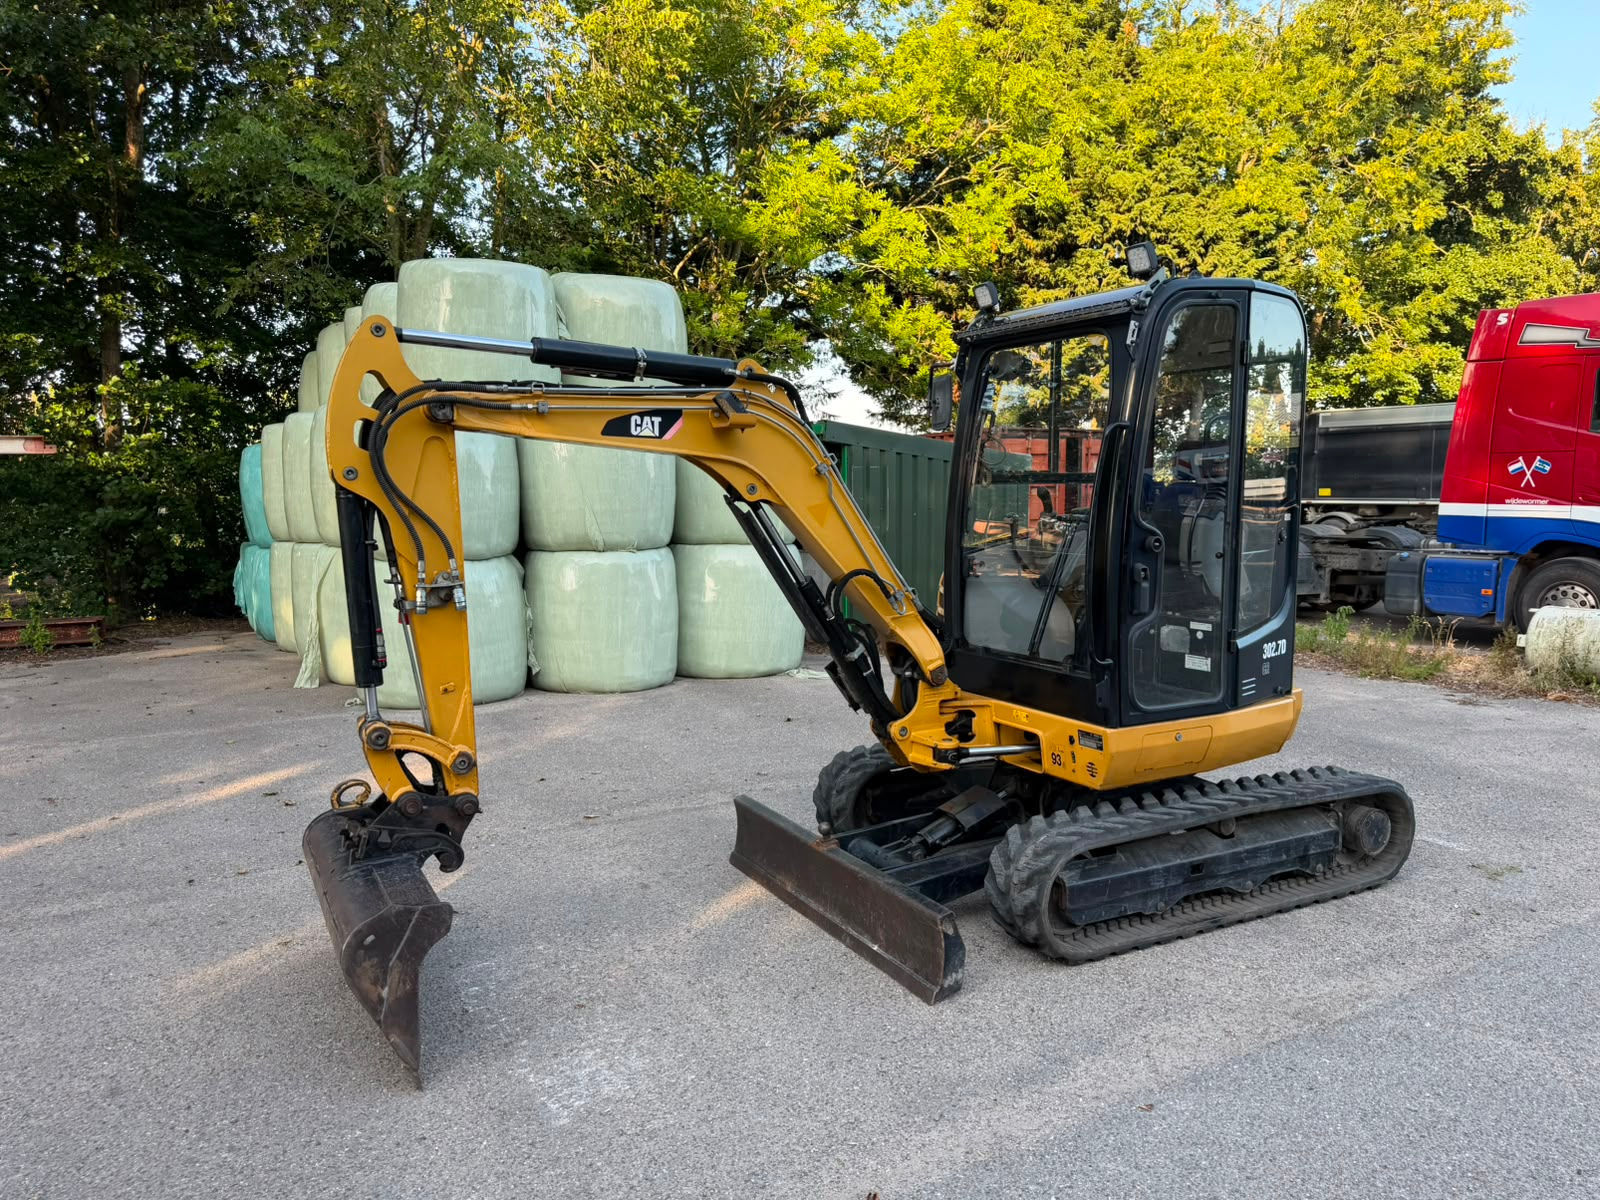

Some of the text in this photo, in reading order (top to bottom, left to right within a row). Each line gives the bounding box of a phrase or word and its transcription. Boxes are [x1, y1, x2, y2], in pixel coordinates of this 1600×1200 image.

[630, 414, 662, 437] CAT
[1262, 638, 1287, 660] 302.7D
[1051, 751, 1062, 767] 93
